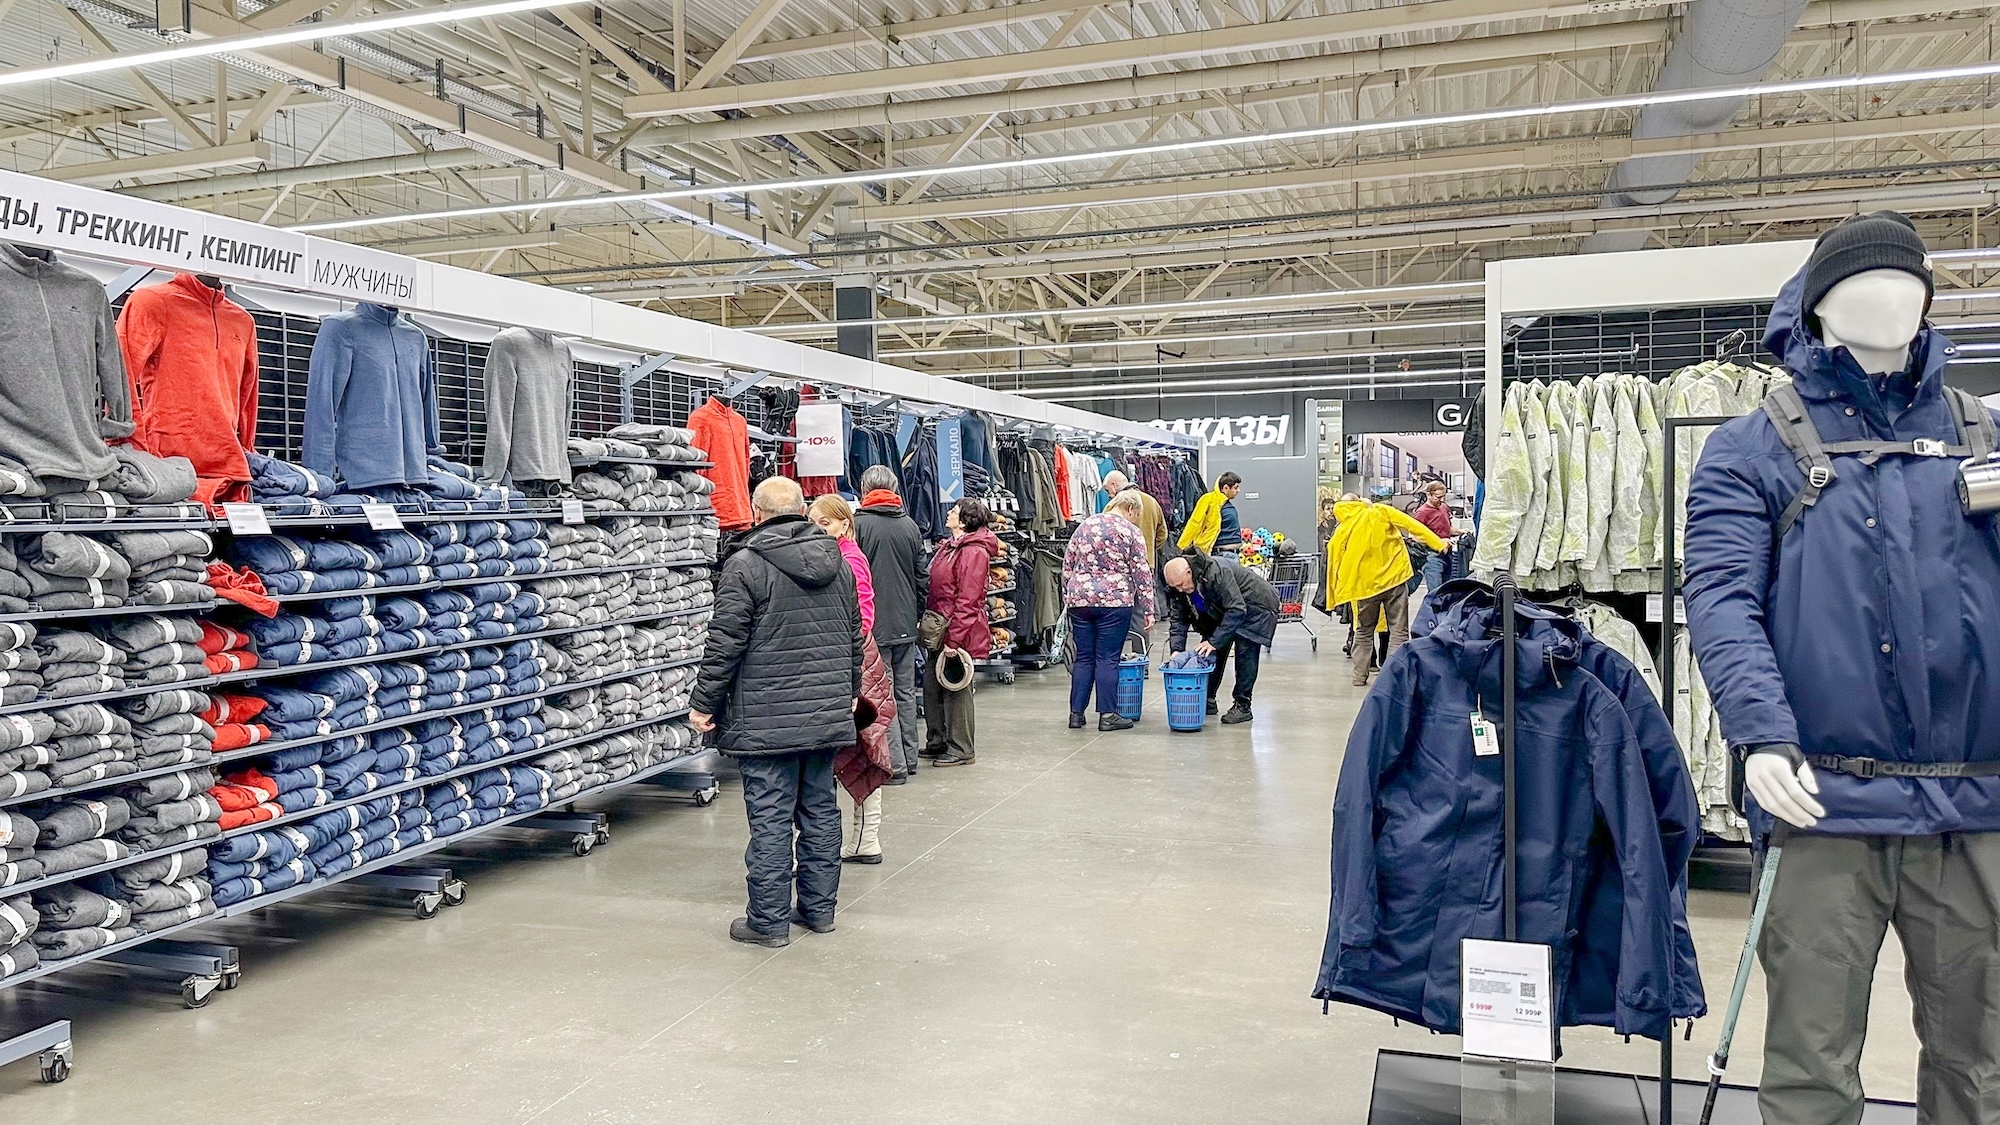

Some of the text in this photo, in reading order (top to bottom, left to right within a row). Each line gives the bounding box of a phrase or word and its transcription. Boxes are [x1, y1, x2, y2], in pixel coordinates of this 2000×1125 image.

[56, 206, 193, 260] ТРЕККИНГ,
[200, 234, 303, 275] КЕМПИНГ
[313, 258, 414, 299] МУЖЧИНЫ
[1316, 405, 1342, 413] GARMIN
[803, 436, 836, 446] -10%
[949, 427, 961, 477] ЗЕРКАЛО
